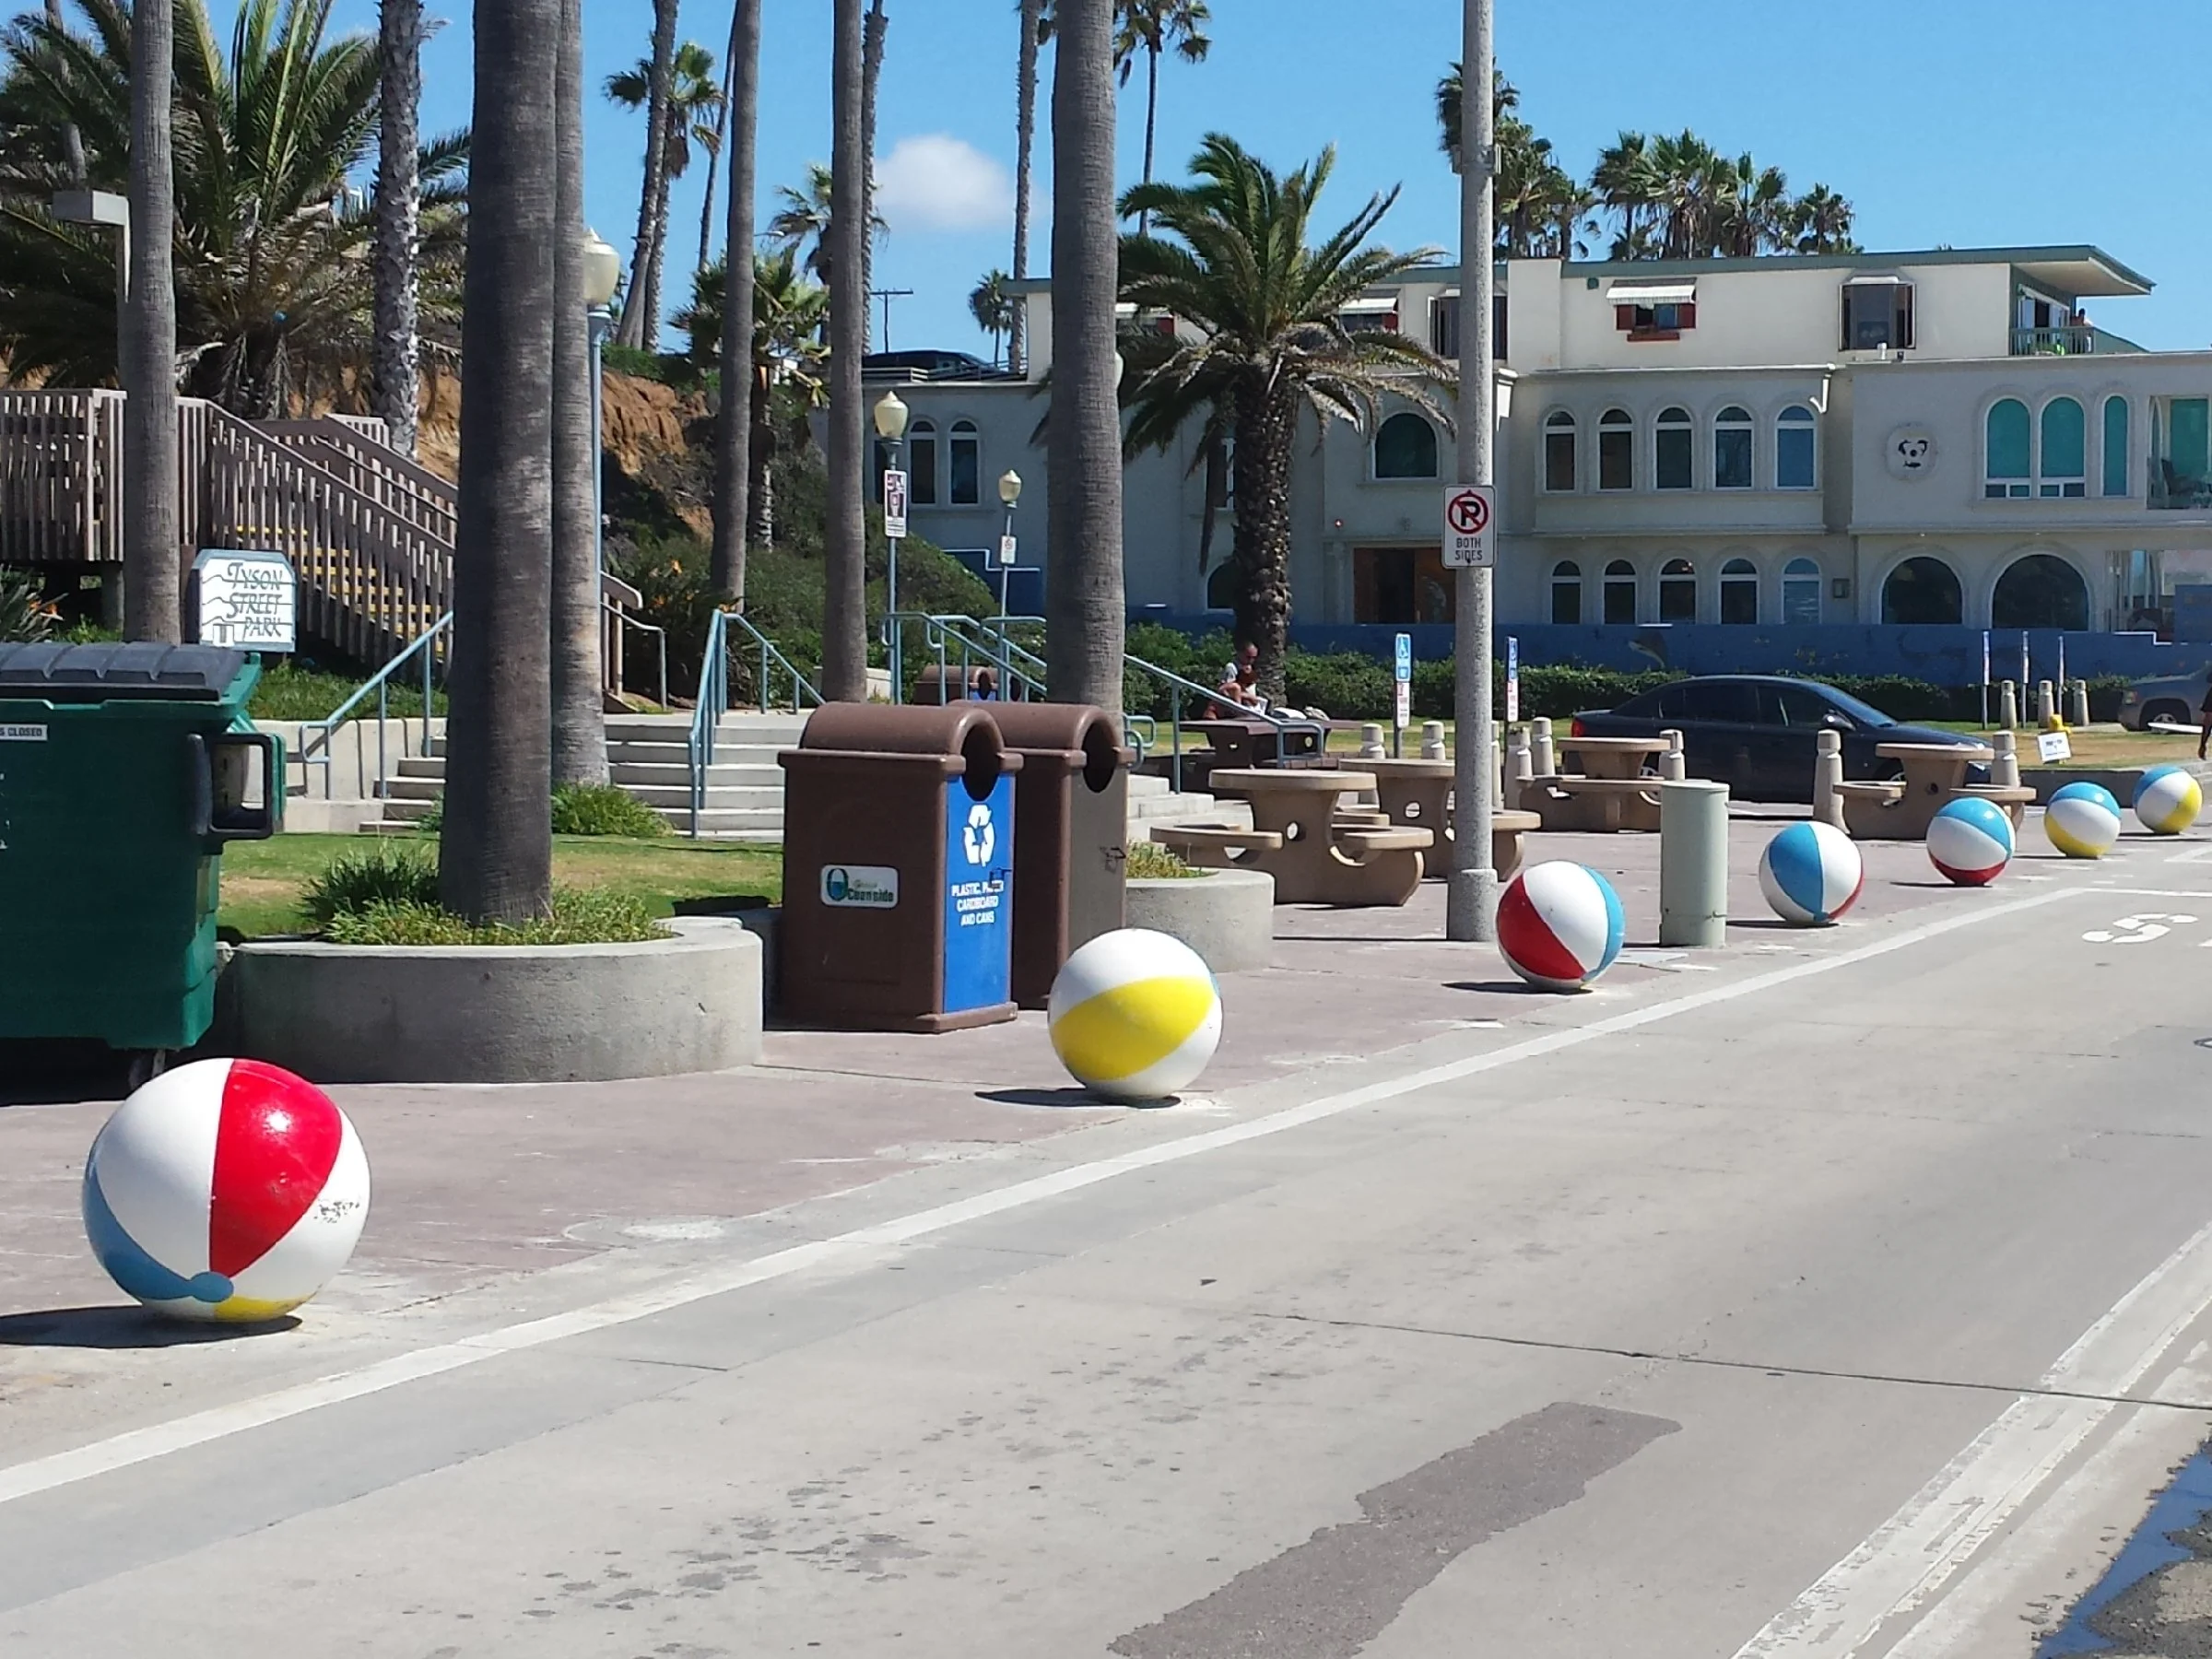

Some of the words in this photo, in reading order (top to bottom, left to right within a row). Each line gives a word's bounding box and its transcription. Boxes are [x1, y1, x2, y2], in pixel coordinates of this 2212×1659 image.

[1456, 537, 1481, 548] BOTH
[1454, 549, 1483, 560] SIDES
[227, 562, 283, 590] TYSON
[226, 592, 283, 618] STREET
[242, 617, 281, 641] PARK
[7, 727, 42, 736] CLOSED
[957, 895, 999, 912] CARDBOARD
[960, 912, 976, 926] AND
[976, 911, 994, 924] CANS
